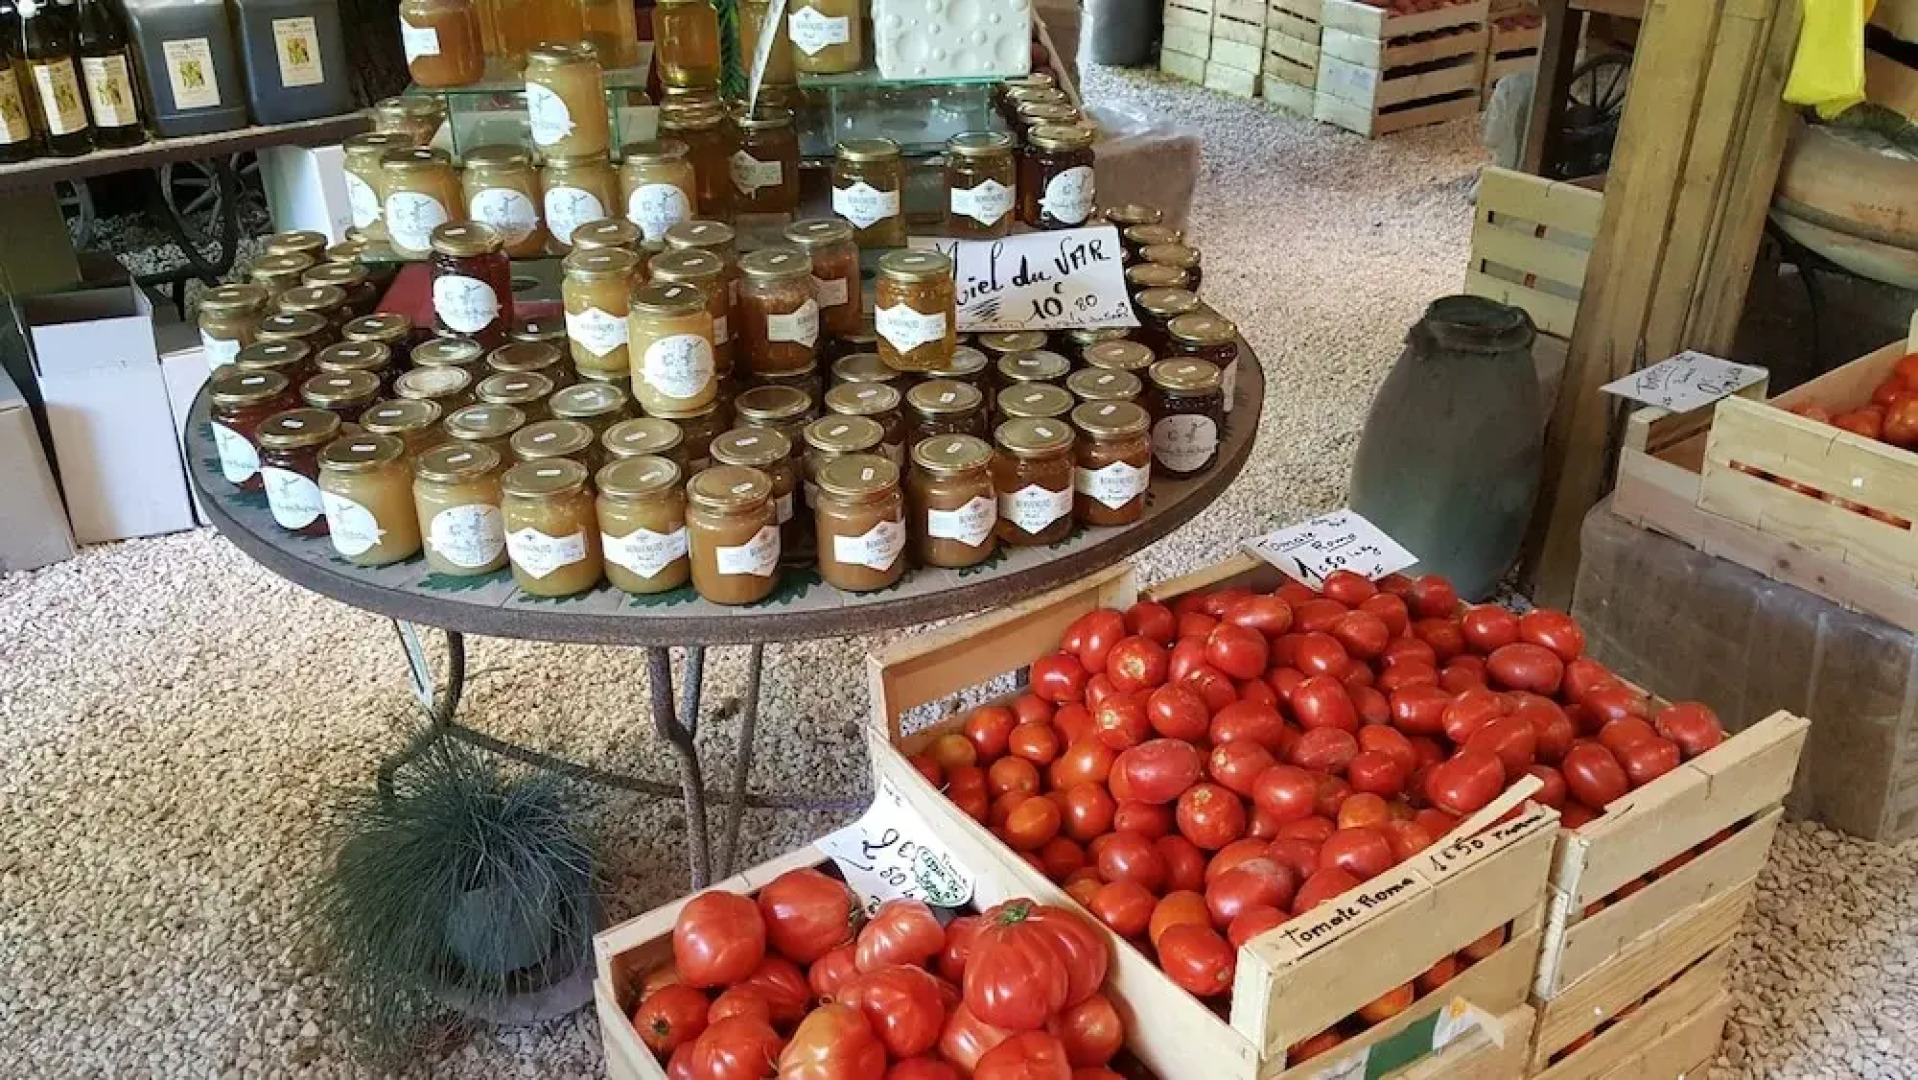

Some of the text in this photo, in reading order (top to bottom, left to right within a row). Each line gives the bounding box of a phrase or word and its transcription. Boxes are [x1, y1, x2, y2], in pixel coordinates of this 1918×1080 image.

[1012, 254, 1052, 287] du
[1279, 905, 1361, 948] Tomate
[1357, 876, 1416, 909] Roma
